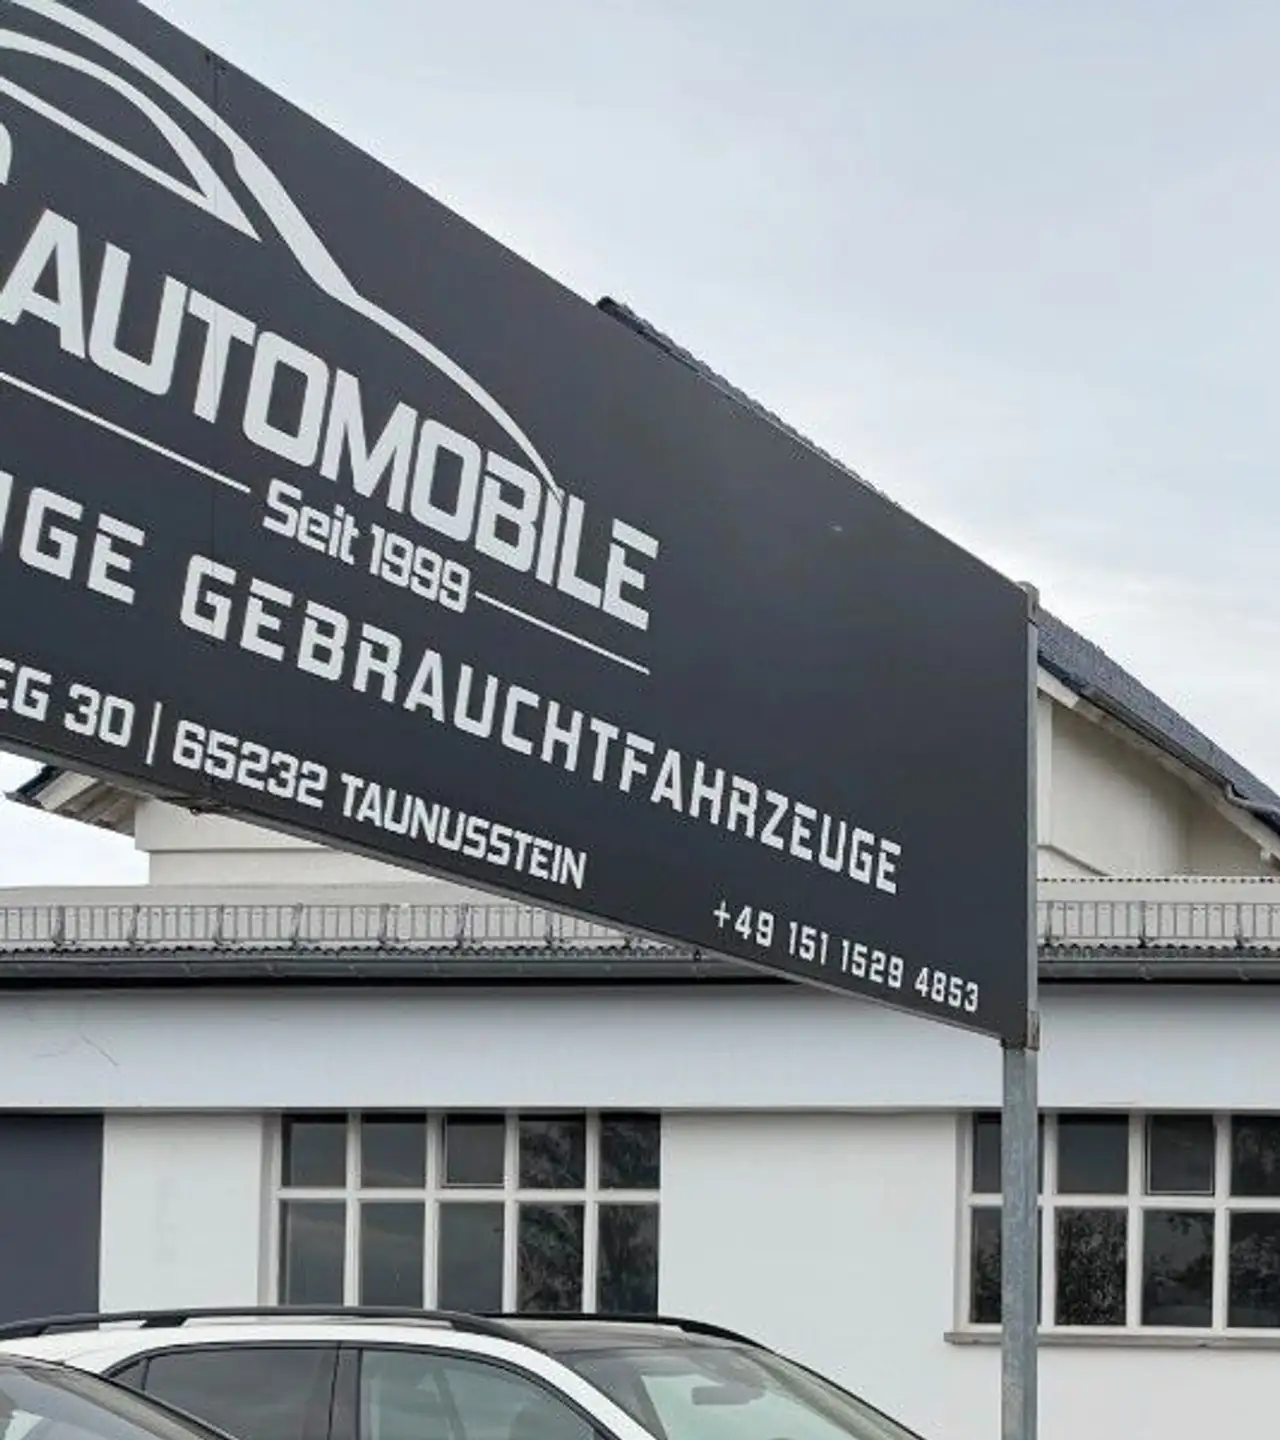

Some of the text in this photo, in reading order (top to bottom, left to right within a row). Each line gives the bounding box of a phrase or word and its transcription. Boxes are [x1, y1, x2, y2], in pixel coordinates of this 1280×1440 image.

[0, 208, 659, 631] AUTOMOBILE
[262, 478, 471, 613] Seit 1999
[64, 683, 135, 748] 30
[172, 720, 328, 809] 65232
[341, 772, 587, 889] TAUNUSSTEIN
[180, 554, 902, 894] GEBRAUCHTFAHRZEUGE
[713, 900, 980, 1013] +49 151 1529 4853
